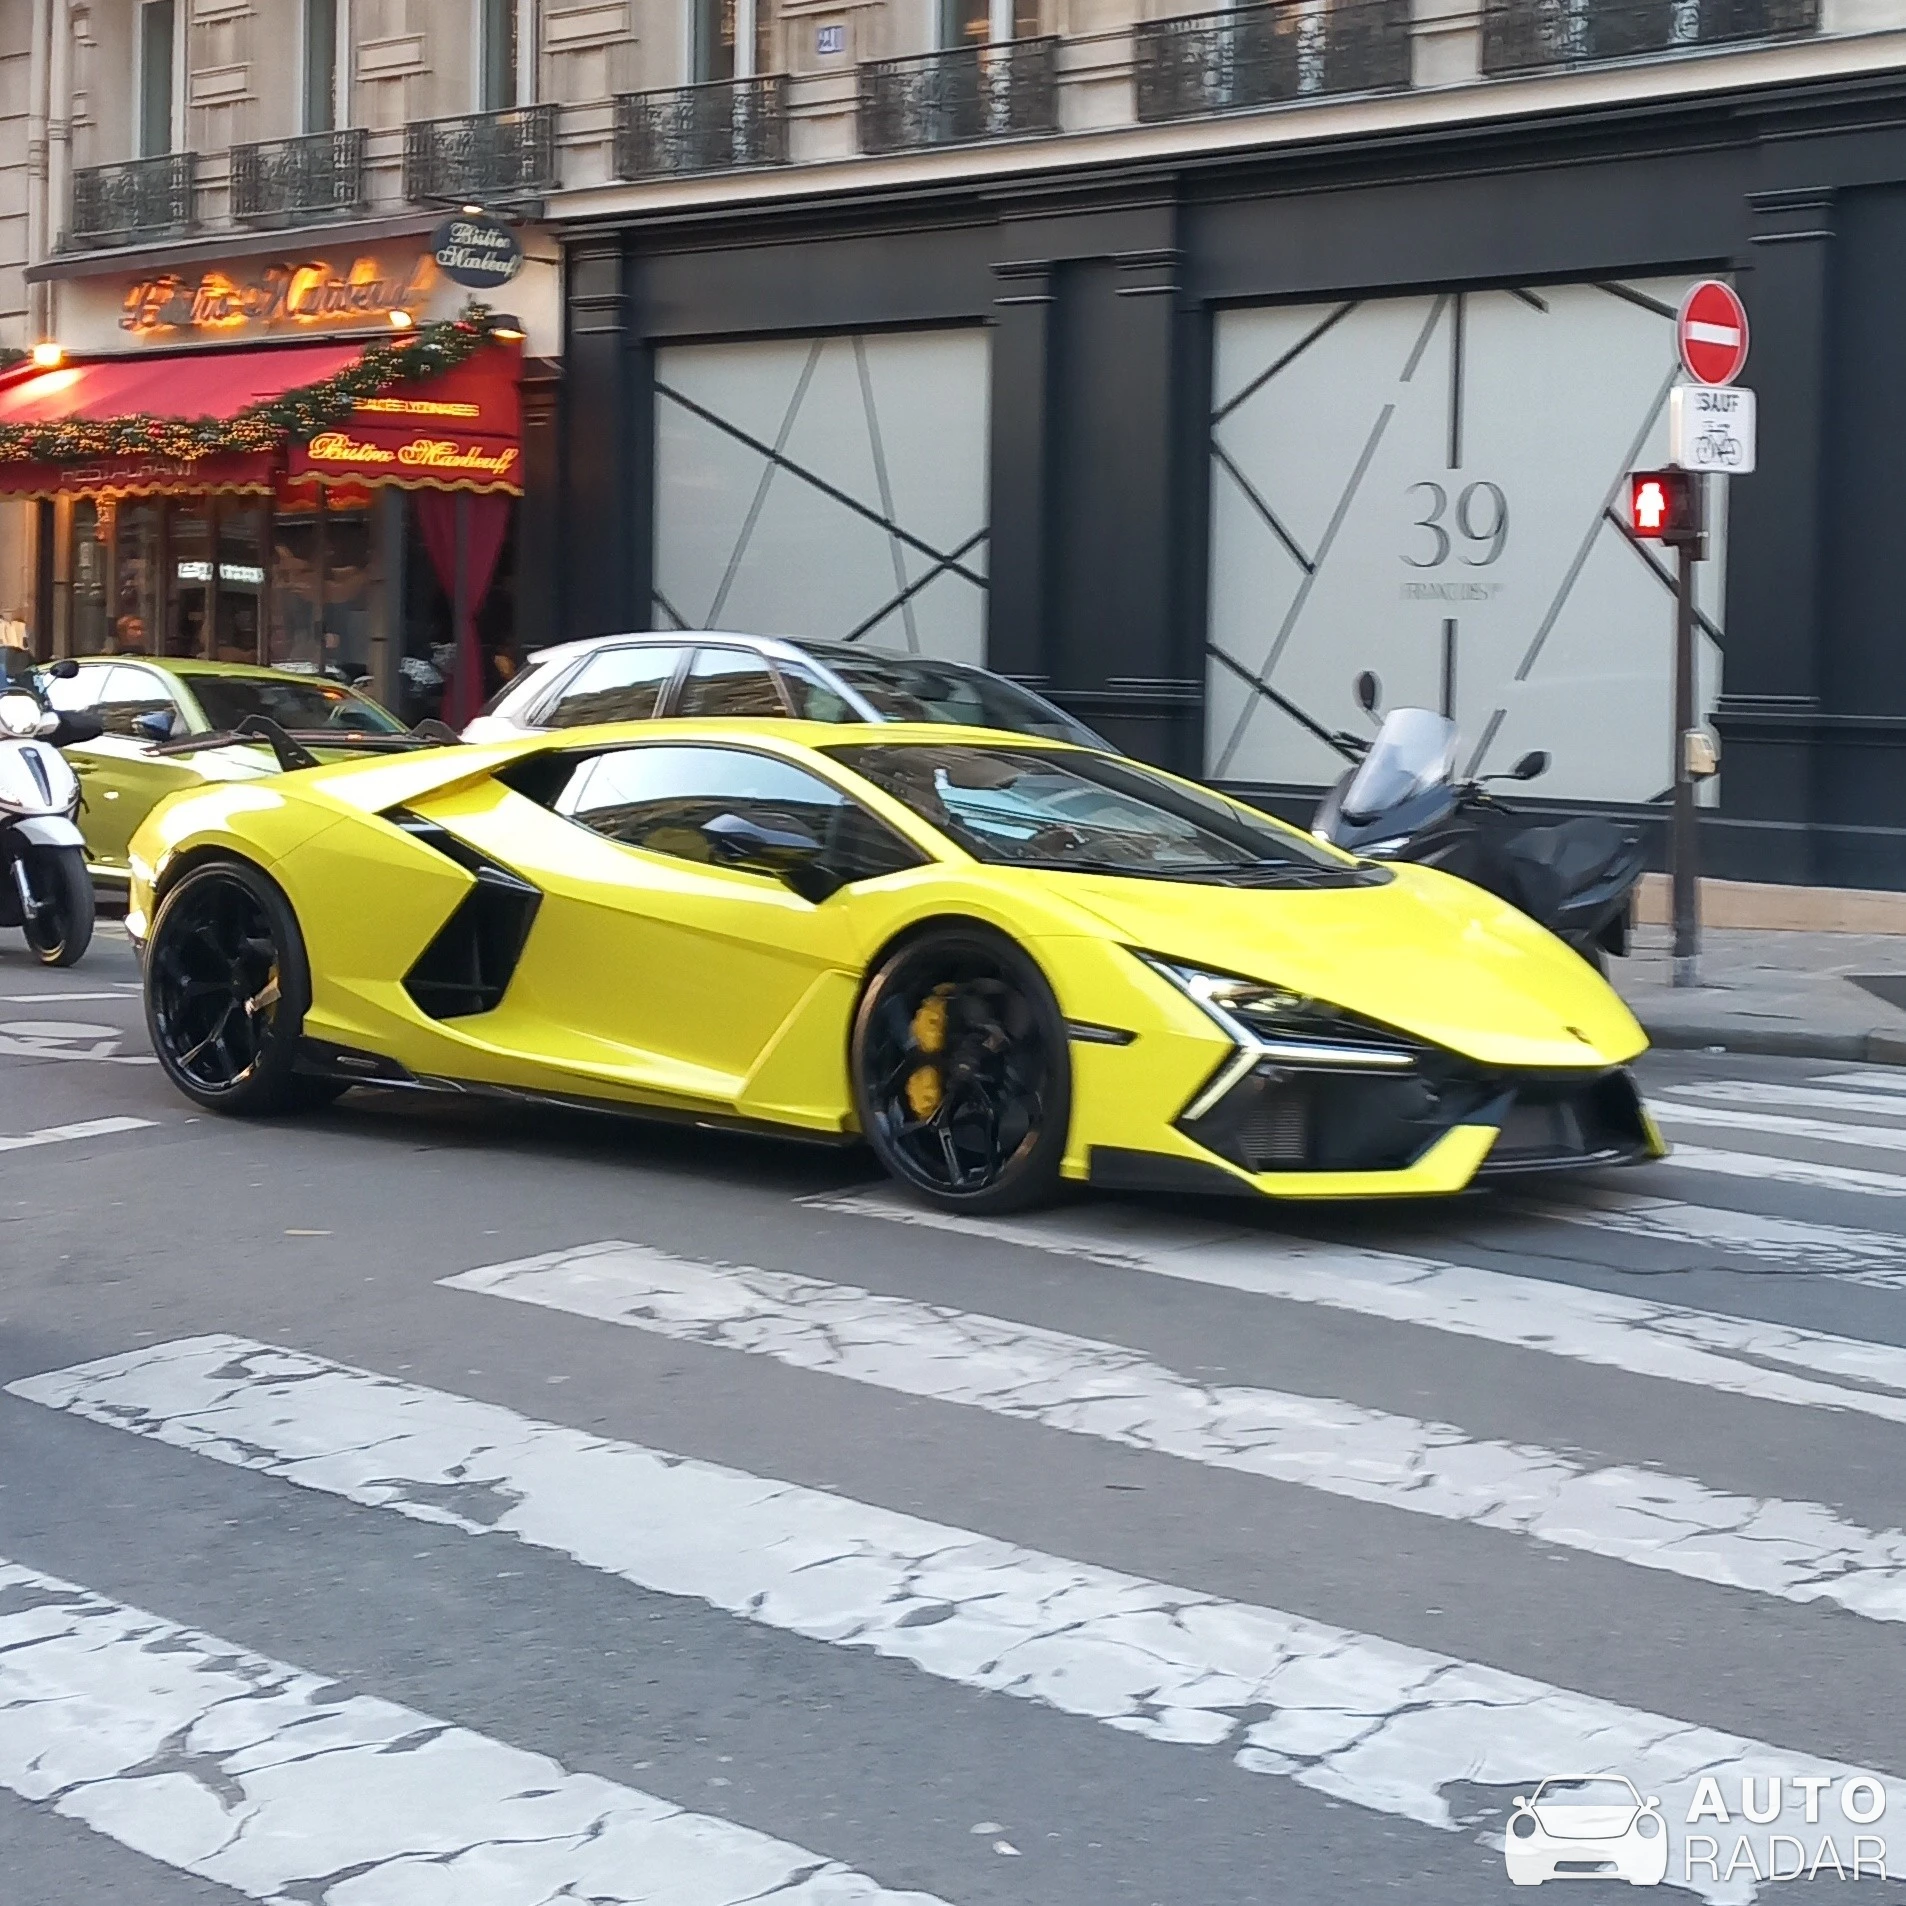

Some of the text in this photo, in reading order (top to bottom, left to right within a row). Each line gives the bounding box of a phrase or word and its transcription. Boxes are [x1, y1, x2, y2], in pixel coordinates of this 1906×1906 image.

[1695, 393, 1739, 412] SAUF
[308, 432, 396, 462] Bistro
[1399, 481, 1509, 568] 39
